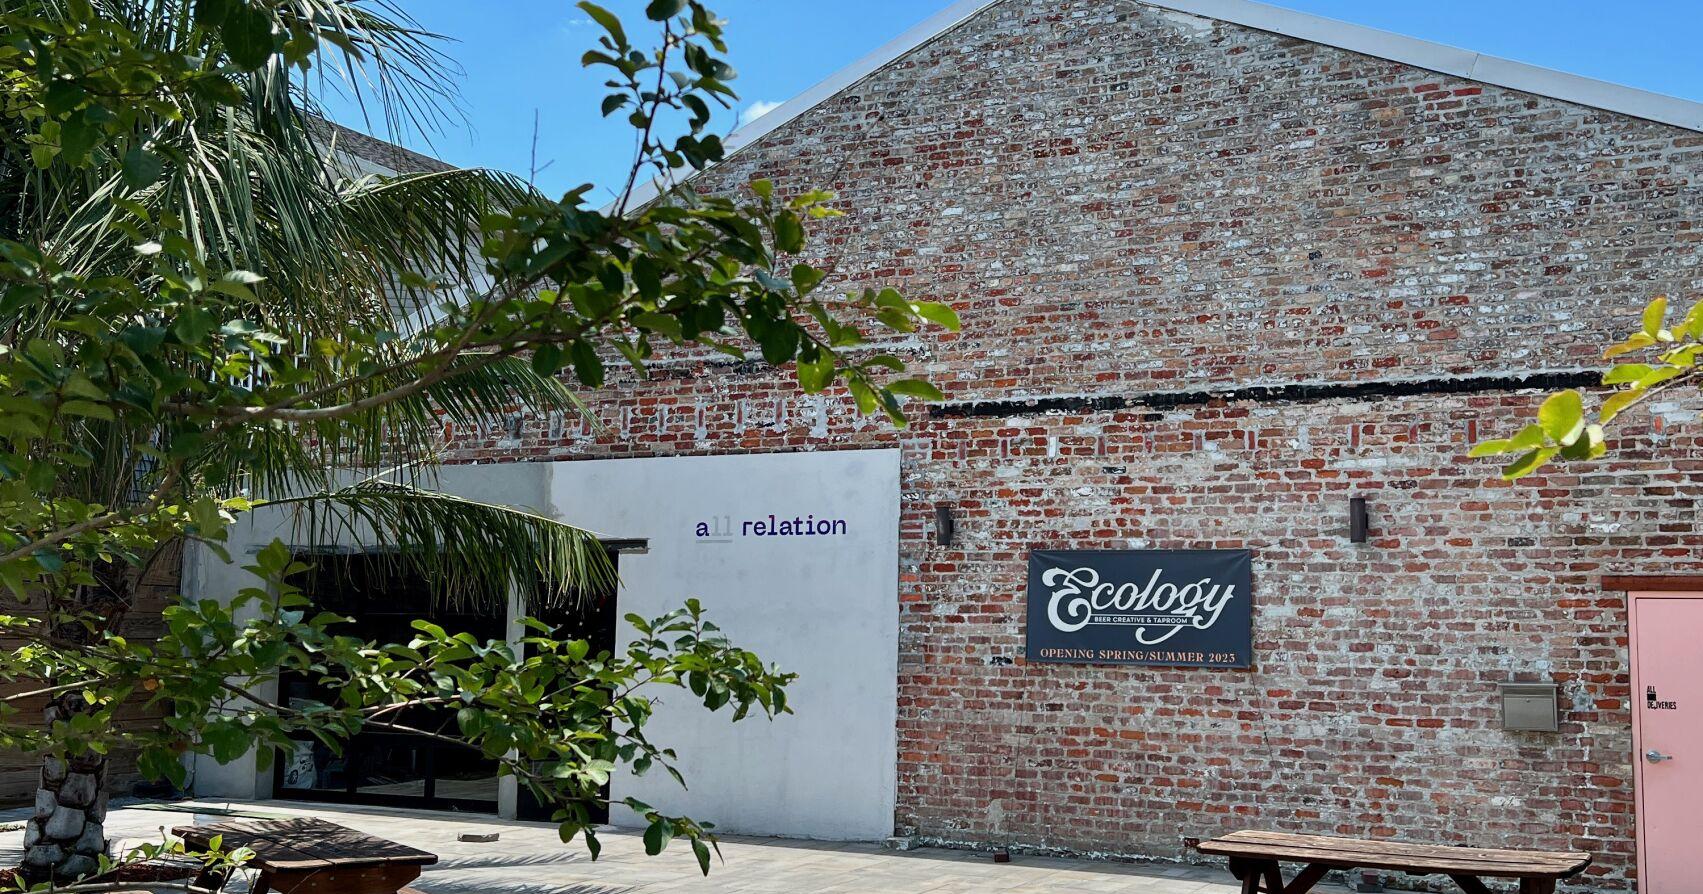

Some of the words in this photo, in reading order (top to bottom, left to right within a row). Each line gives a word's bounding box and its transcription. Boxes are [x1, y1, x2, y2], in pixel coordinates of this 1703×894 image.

[695, 515, 733, 537] all
[742, 514, 847, 536] relation
[1042, 567, 1236, 645] Ecology
[1040, 647, 1094, 659] OPENING
[1099, 650, 1204, 662] SPRING/SUMMER
